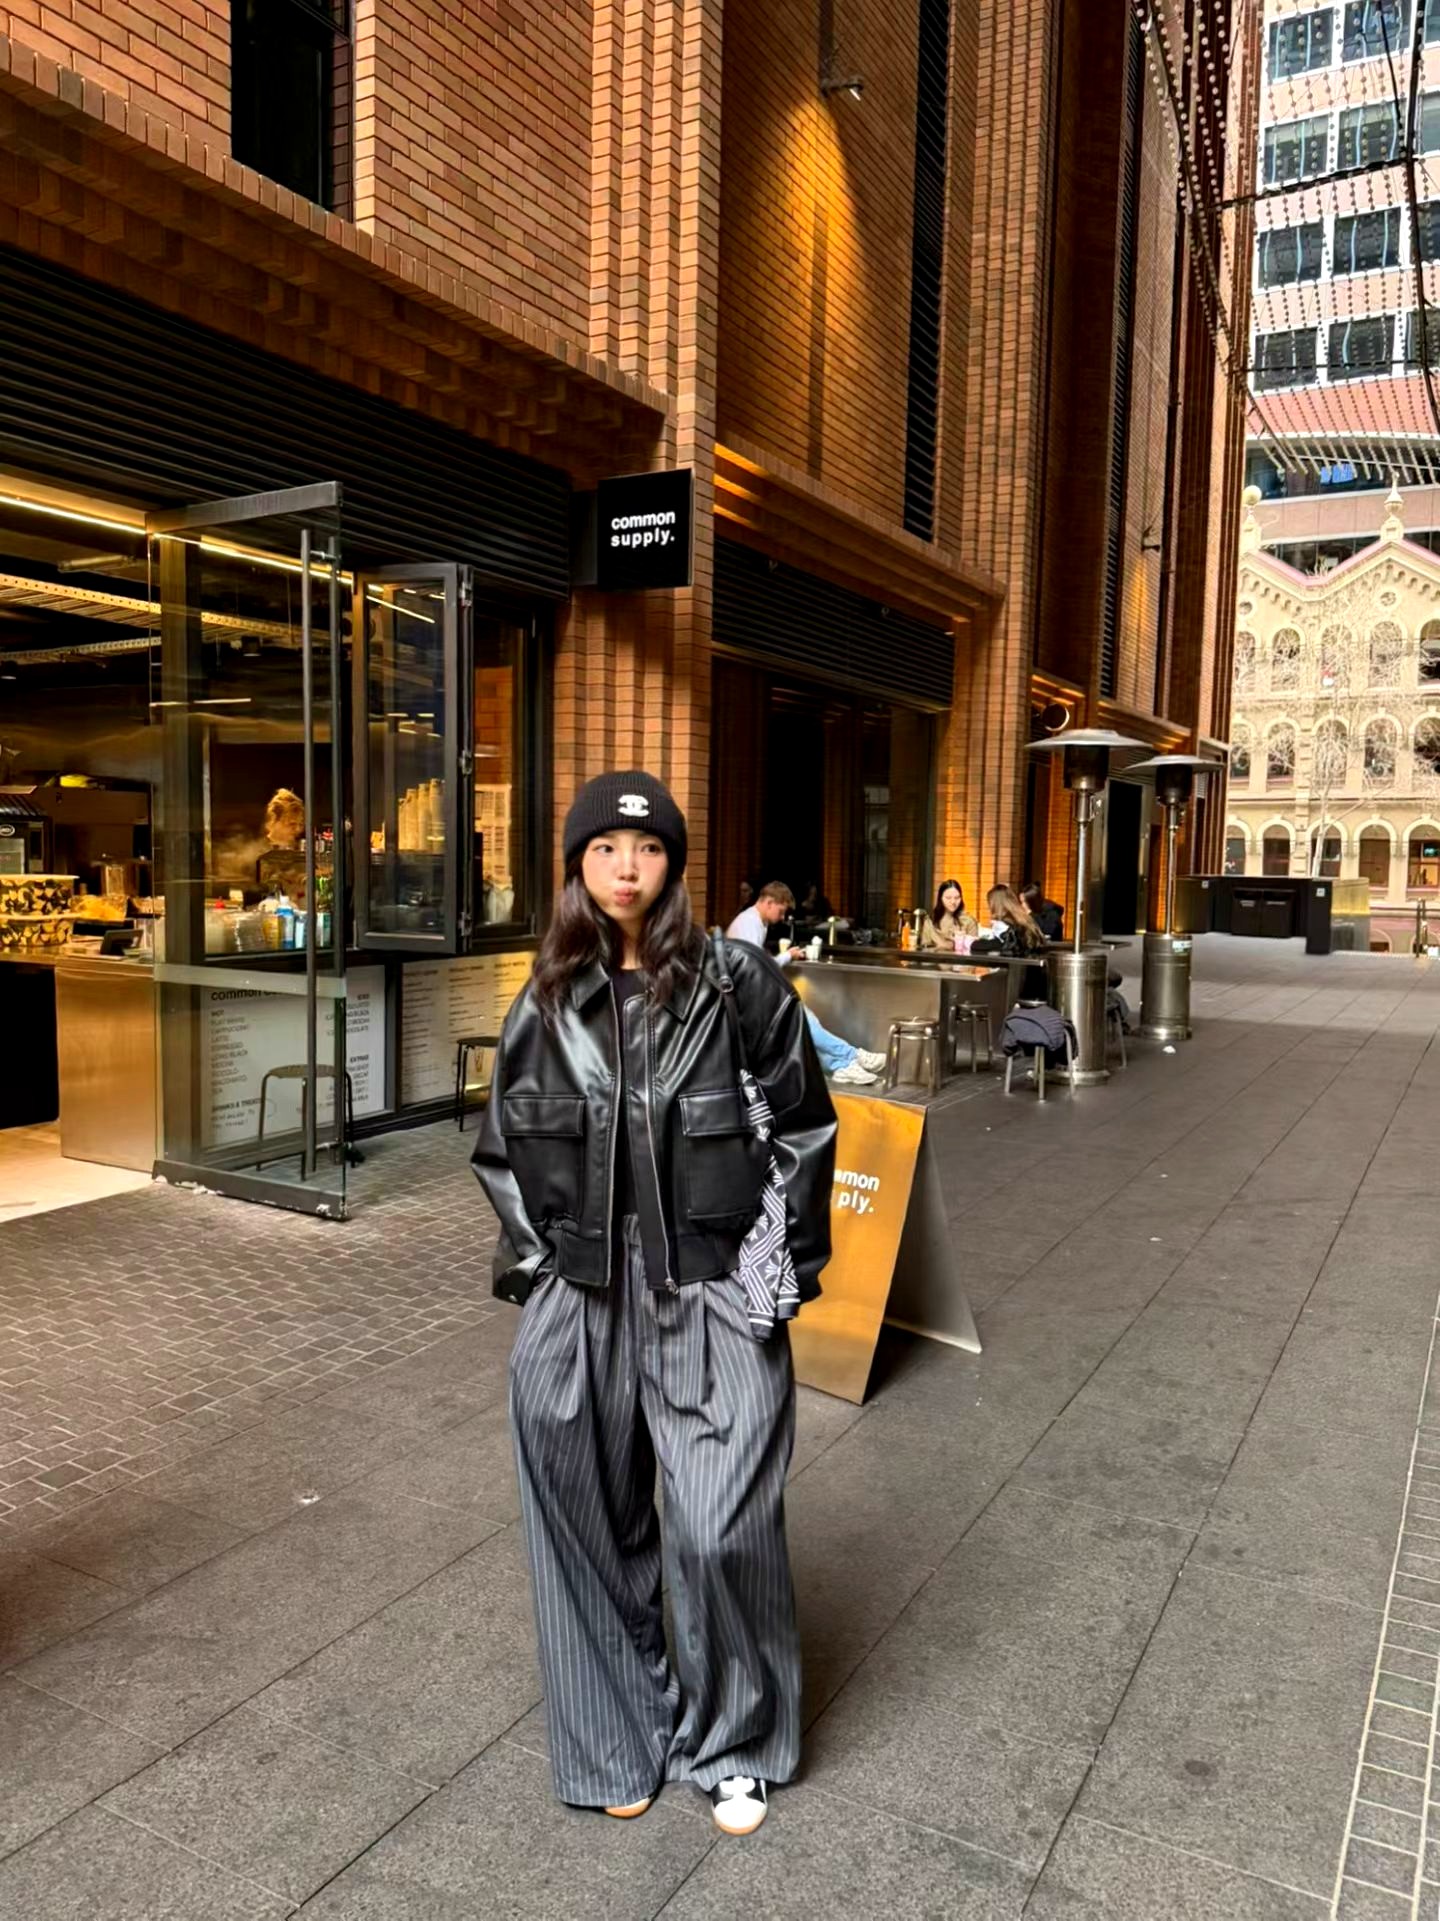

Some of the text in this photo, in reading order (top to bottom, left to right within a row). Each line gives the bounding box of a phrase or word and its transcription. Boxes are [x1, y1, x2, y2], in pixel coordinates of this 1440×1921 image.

[611, 511, 676, 530] common
[610, 527, 675, 549] supply.
[211, 990, 262, 1001] common
[837, 1190, 874, 1214] ply.
